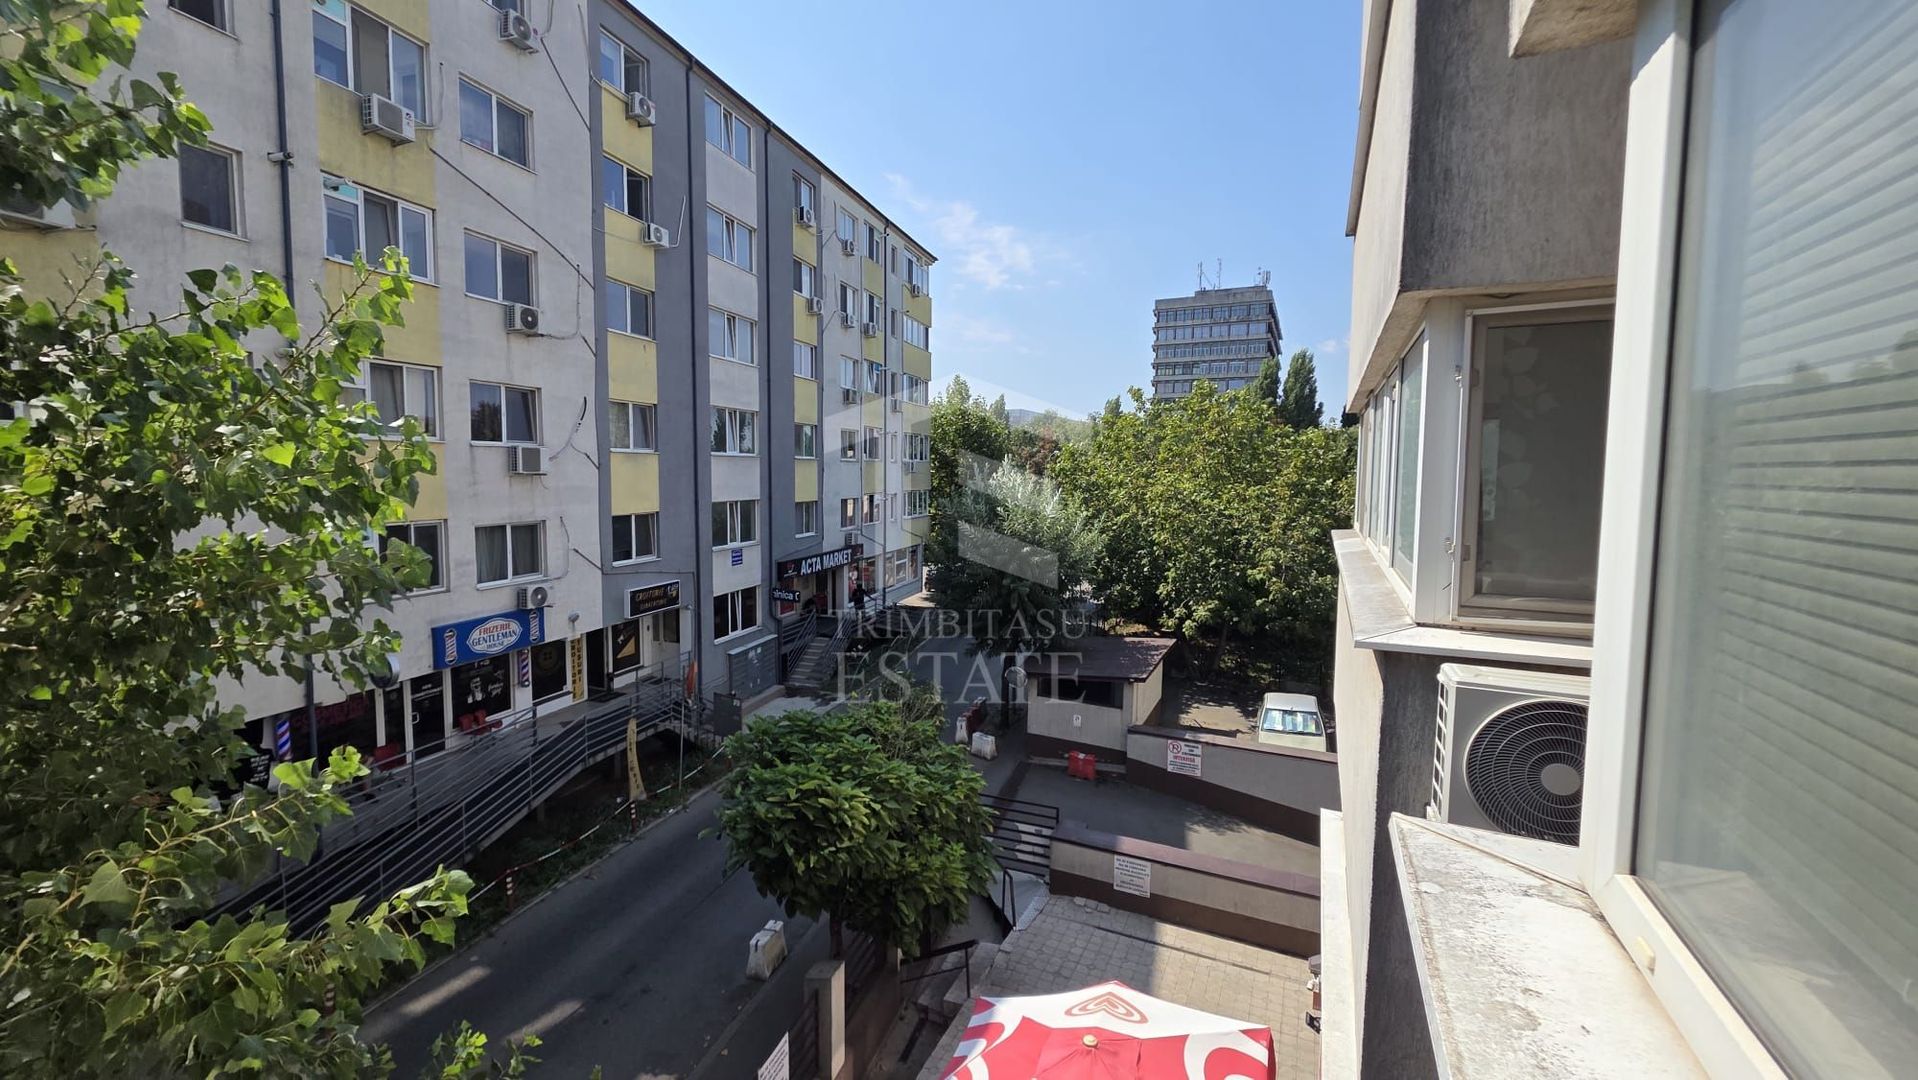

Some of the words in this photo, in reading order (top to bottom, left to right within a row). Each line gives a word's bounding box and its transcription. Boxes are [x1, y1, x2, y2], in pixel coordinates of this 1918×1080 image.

[800, 559, 822, 576] ACTA
[823, 549, 852, 569] MARKET
[471, 629, 517, 647] GENTLEMAN
[478, 622, 512, 636] FRIZERIE
